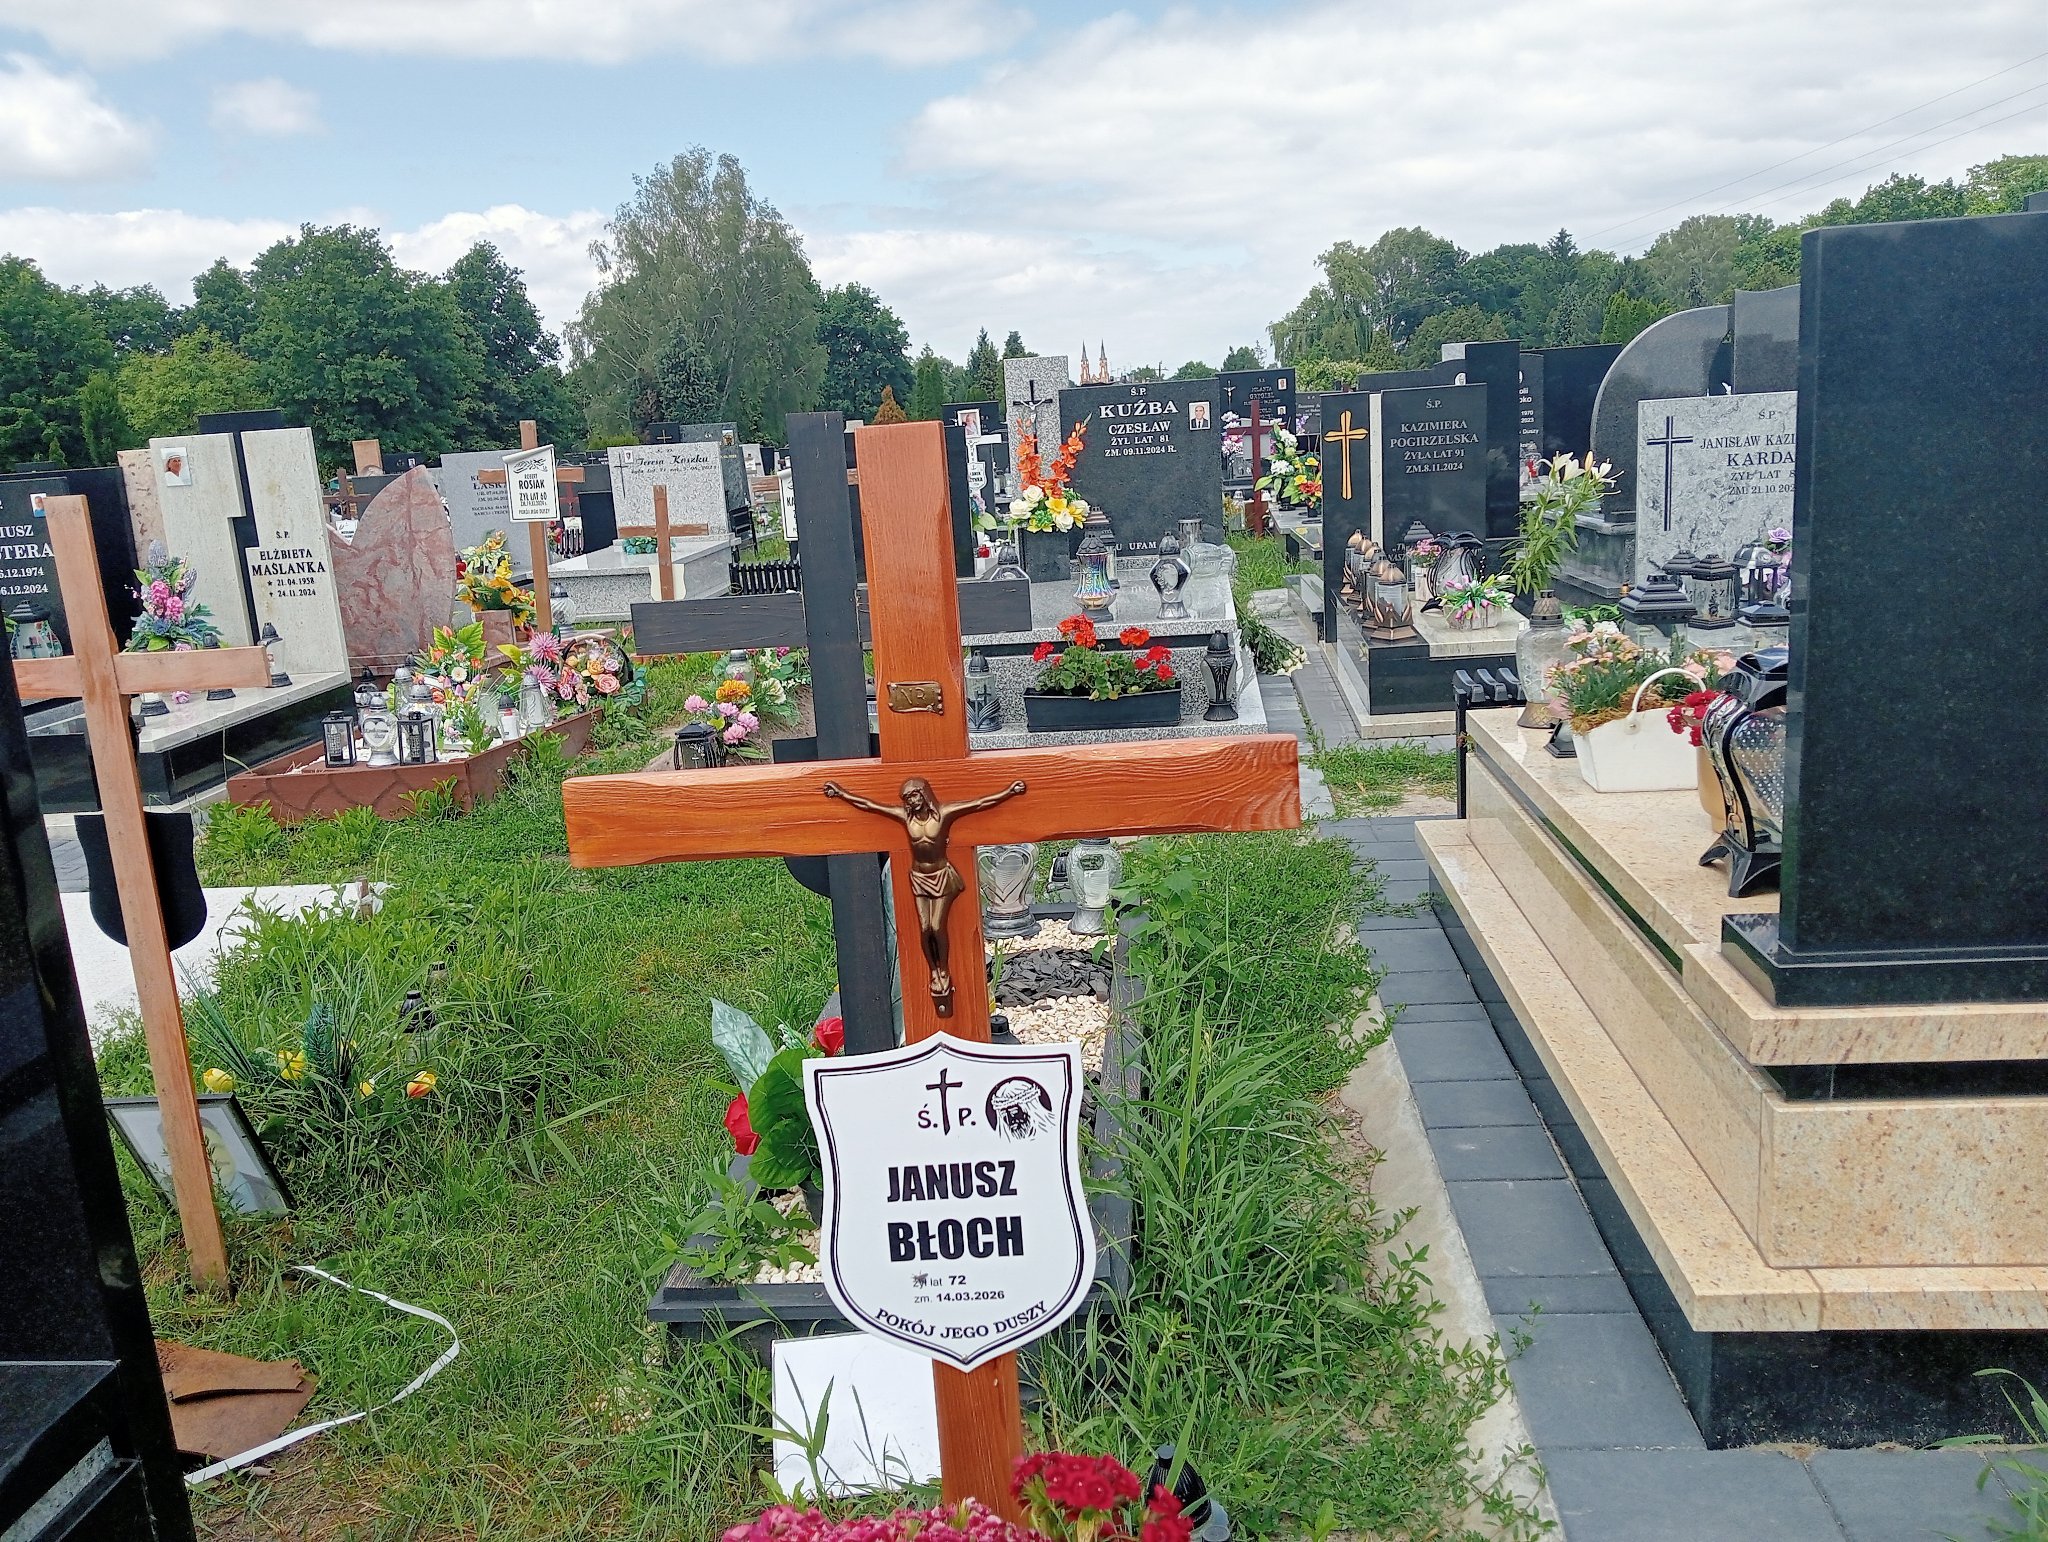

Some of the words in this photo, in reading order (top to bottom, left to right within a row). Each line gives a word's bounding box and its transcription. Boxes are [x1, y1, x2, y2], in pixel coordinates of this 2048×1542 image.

[1099, 399, 1179, 419] KUŹBA
[1108, 421, 1171, 435] CZESŁAW
[1400, 420, 1468, 433] KAZIMIERA
[1134, 436, 1154, 444] LAT
[1159, 435, 1169, 443] 81
[1389, 433, 1479, 449] POGIRZELSKA
[1700, 435, 1760, 450] JANISŁAW
[1105, 448, 1121, 457] ZM.
[1123, 446, 1165, 456] 09.11.2024
[1167, 445, 1177, 453] R.
[1433, 449, 1453, 459] LAT
[1454, 449, 1465, 457] 91
[1727, 451, 1796, 467] KARDA
[1760, 469, 1781, 480] LAT
[519, 480, 545, 490] ROSIAK
[530, 492, 539, 501] LAT
[1129, 541, 1157, 551] UFAM
[260, 548, 313, 560] ELŻBIETA
[251, 562, 326, 576] MAŚLANKA
[958, 1107, 976, 1126] P.
[887, 1160, 1018, 1203] JANUSZ
[887, 1215, 1024, 1262] BŁOCH
[930, 1278, 942, 1287] lat
[949, 1275, 967, 1286] 72
[914, 1294, 932, 1304] zm.
[936, 1290, 1005, 1302] 14.03.2026
[875, 1308, 936, 1337] POKÓJ
[940, 1325, 989, 1339] JEGO
[993, 1300, 1047, 1334] DUSZY
